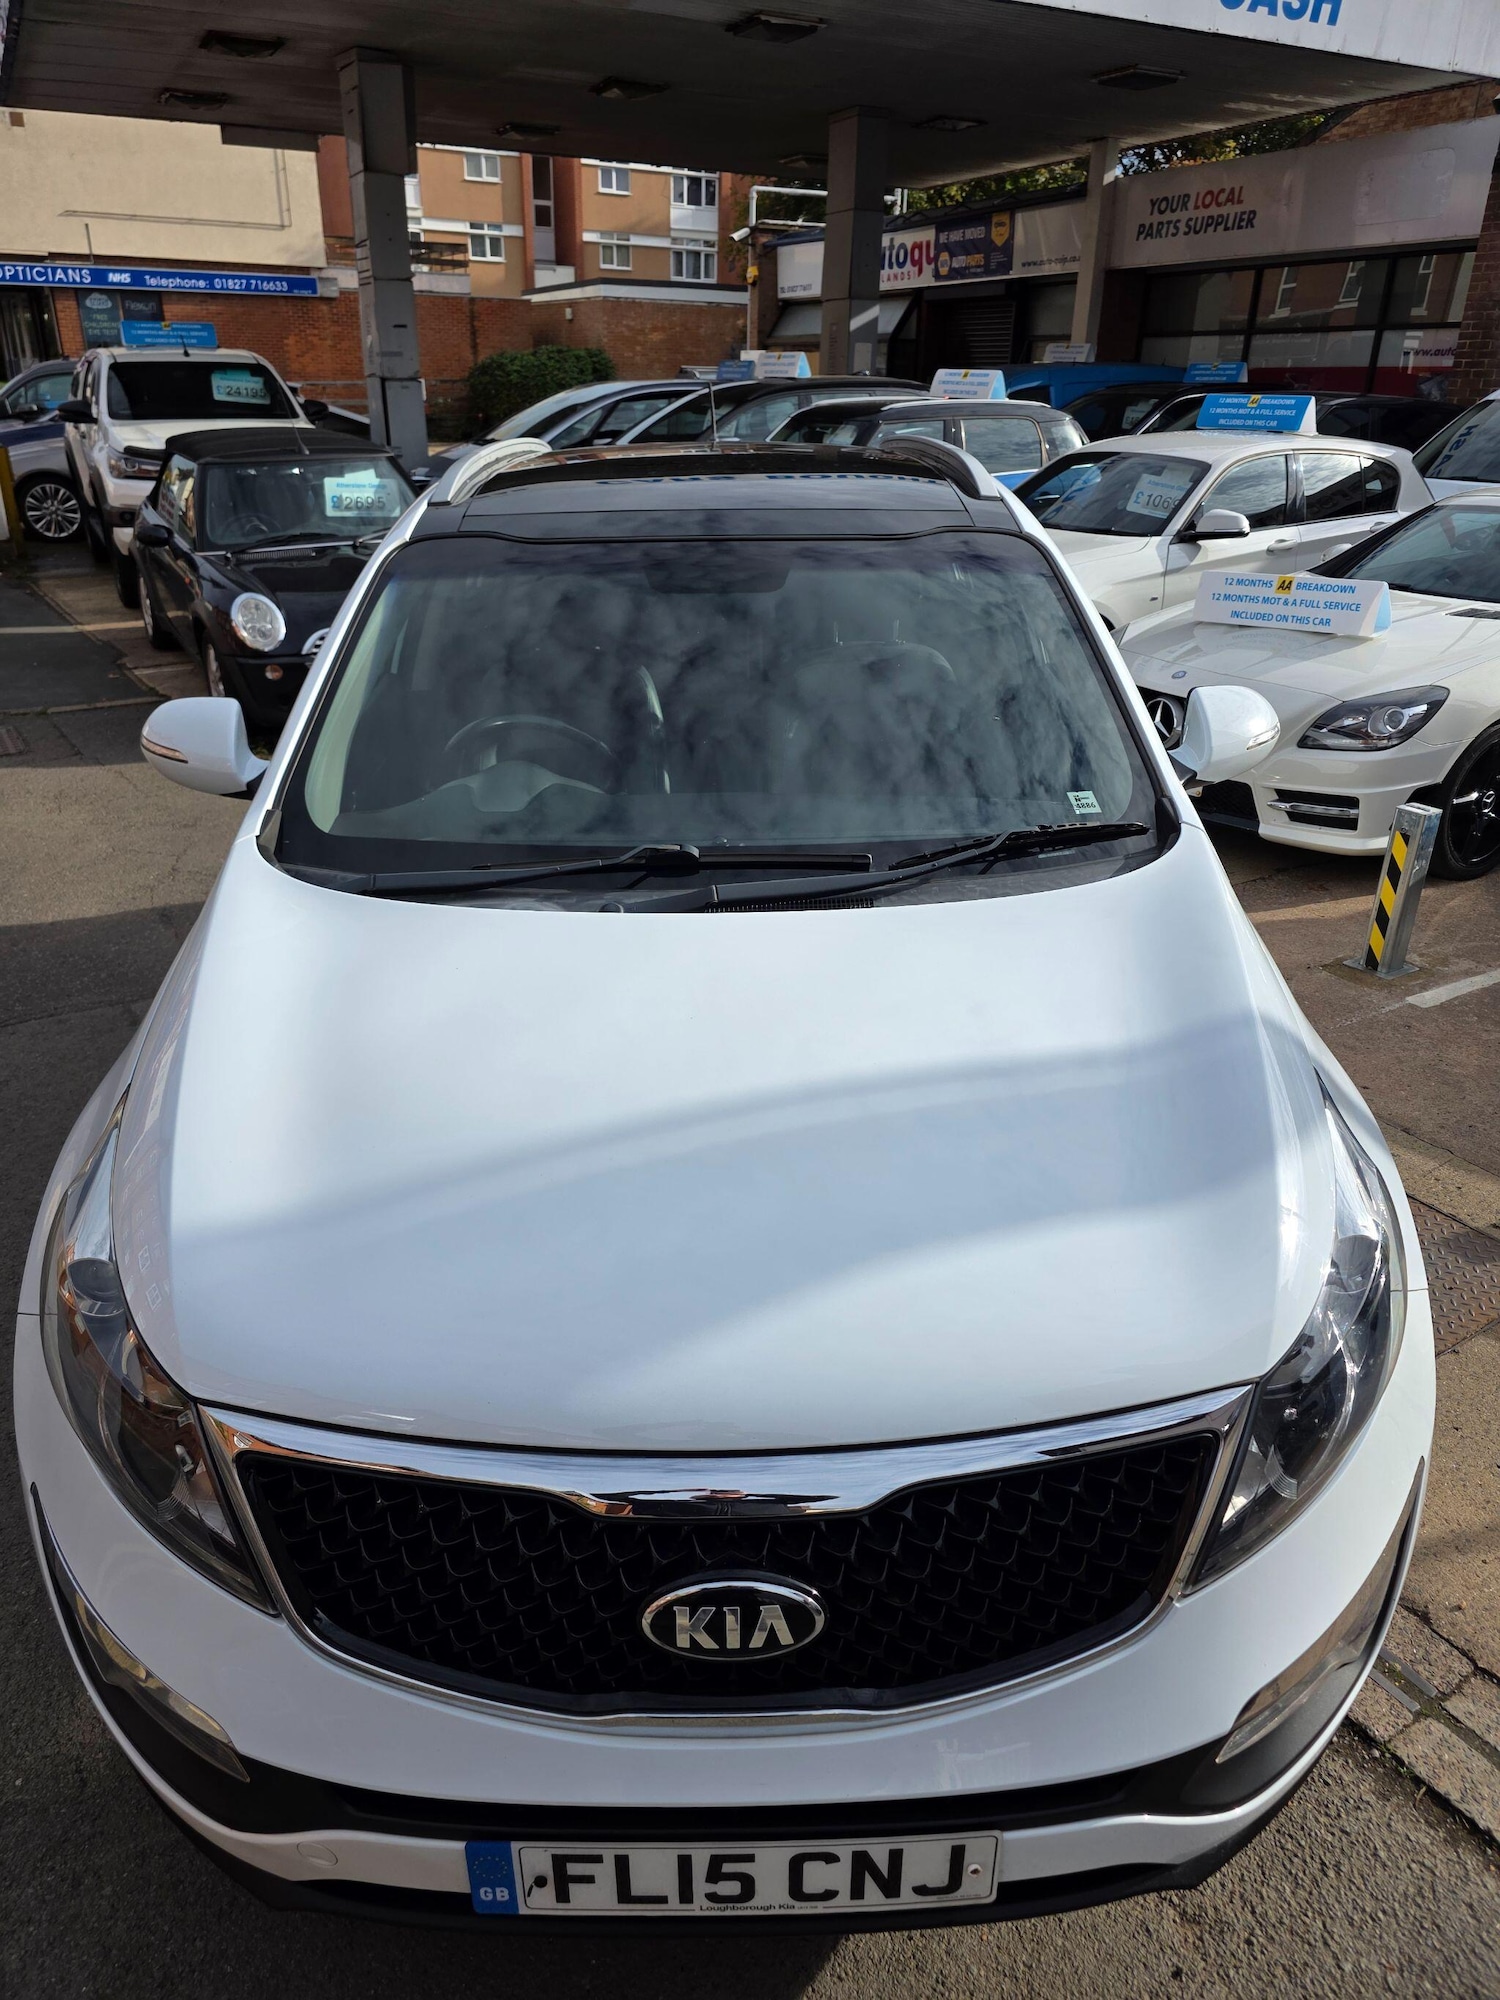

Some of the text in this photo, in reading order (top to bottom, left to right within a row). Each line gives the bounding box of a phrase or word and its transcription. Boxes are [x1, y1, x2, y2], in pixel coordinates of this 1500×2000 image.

[1149, 186, 1244, 216] YOUR LOCAL
[1135, 209, 1257, 242] PARTS SUPPLIER
[966, 253, 985, 267] PARTS
[0, 265, 91, 284] PTICIANS
[108, 272, 131, 284] NHS
[144, 275, 210, 289] Telephone:
[214, 278, 246, 290] 01827
[250, 279, 288, 292] 716633
[1260, 398, 1296, 406] BREAKDOWN
[1218, 418, 1244, 426] INCLUDED
[1224, 577, 1356, 594] 12 MONTHS AA BREAKDOWN
[1211, 592, 1361, 612] 12 MONTHS MOT & A FULL SERVICE
[1230, 610, 1332, 627] INCLUDED ON THIS CAR
[673, 1605, 795, 1649] KIA
[551, 1844, 966, 1904] FL15 CNJ
[479, 1886, 510, 1901] GB
[700, 1903, 777, 1913] Loughborough
[778, 1903, 795, 1911] Kia
